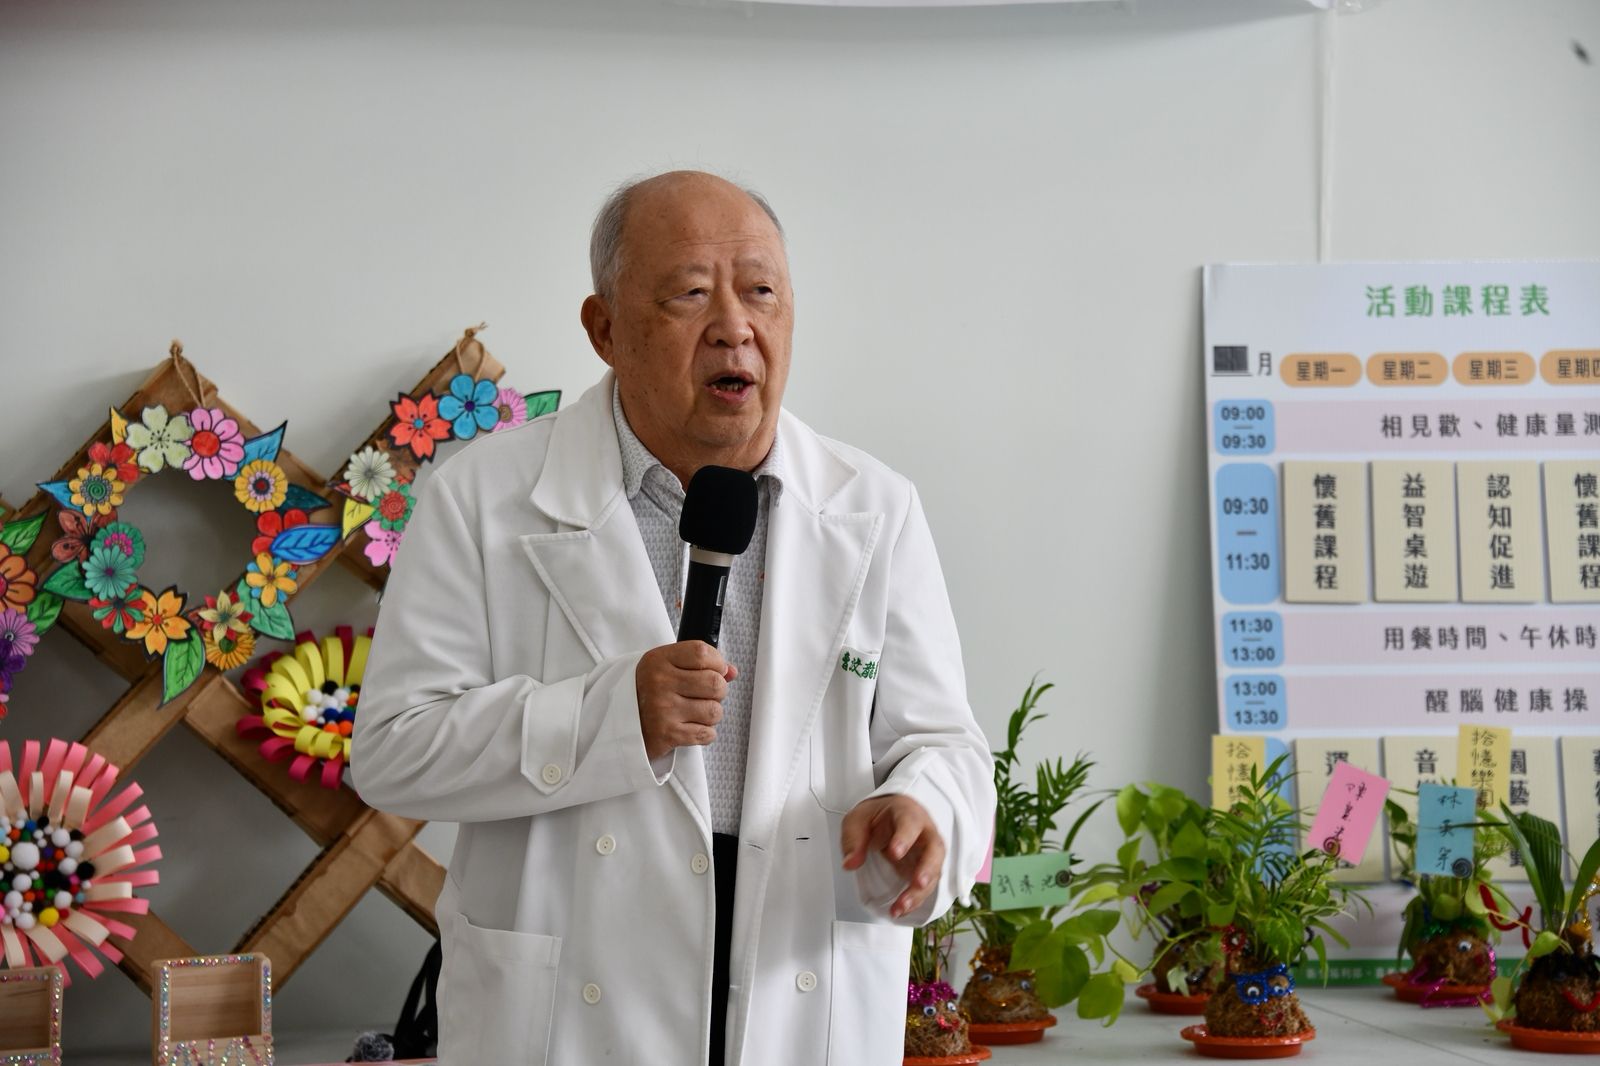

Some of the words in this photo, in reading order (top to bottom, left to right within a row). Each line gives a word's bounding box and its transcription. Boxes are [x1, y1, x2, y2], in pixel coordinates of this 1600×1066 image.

[1366, 283, 1551, 318] 活動課程表
[1257, 352, 1272, 377] 月
[1296, 360, 1346, 382] 星期一
[1382, 360, 1432, 381] 星期二
[1469, 359, 1519, 380] 星期三
[1221, 406, 1265, 421] 09:00
[1222, 435, 1266, 449] 09:30
[1223, 498, 1269, 515] 09:30
[1313, 474, 1338, 590] 懷舊課程
[1402, 473, 1429, 590] 益智桌遊
[1487, 473, 1515, 590] 認知促進
[1574, 472, 1600, 590] 懷舊課程
[1226, 553, 1270, 571] 11:30
[1230, 619, 1273, 634] 11:30
[1231, 647, 1275, 662] 13:00
[1233, 681, 1277, 696] 13:00
[1425, 687, 1589, 713] 醒腦健康操
[1235, 710, 1278, 725] 13:30
